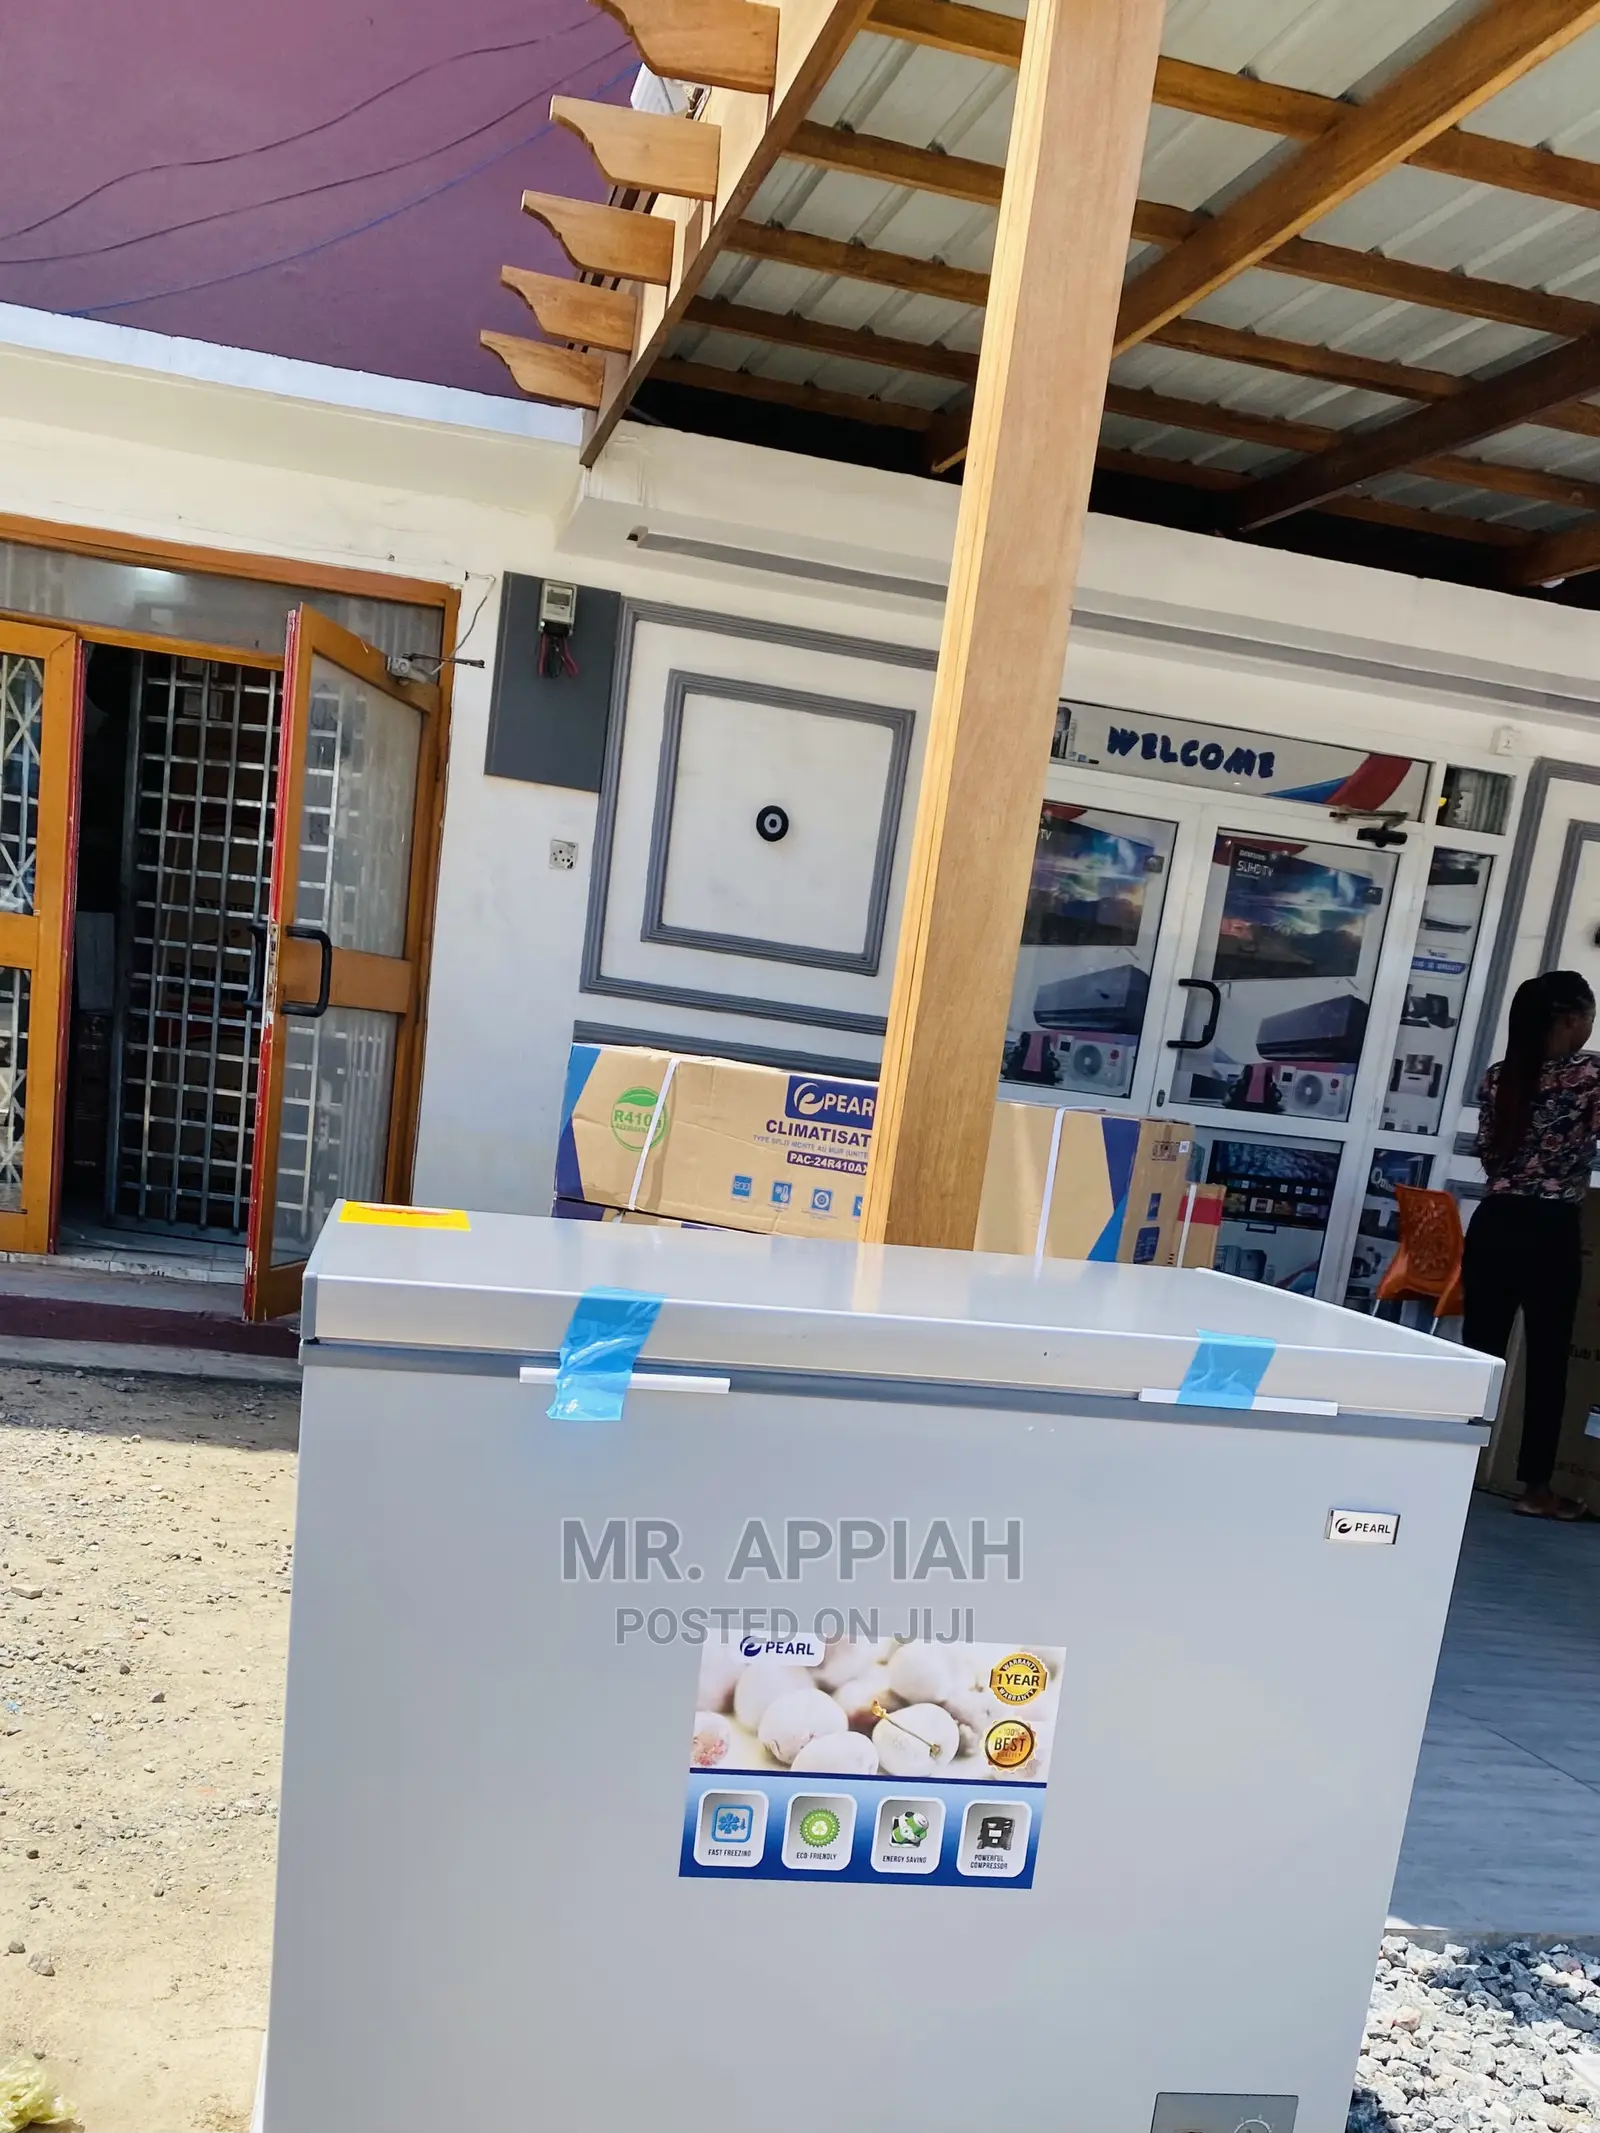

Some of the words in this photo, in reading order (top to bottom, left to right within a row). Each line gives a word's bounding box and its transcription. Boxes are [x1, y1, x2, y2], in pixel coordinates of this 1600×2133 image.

[1106, 726, 1275, 778] WELCOME
[1355, 1522, 1391, 1534] PEARL
[765, 1641, 815, 1656] PEARL
[1002, 1658, 1038, 1673] WARRANTY
[997, 1674, 1003, 1685] 1
[1005, 1673, 1040, 1687] YEAR
[999, 1687, 1035, 1702] WARRANTY
[993, 1736, 1026, 1752] BEST
[724, 1849, 752, 1857] FREEZING
[882, 1855, 904, 1863] ENERGY
[906, 1856, 927, 1864] SAVING
